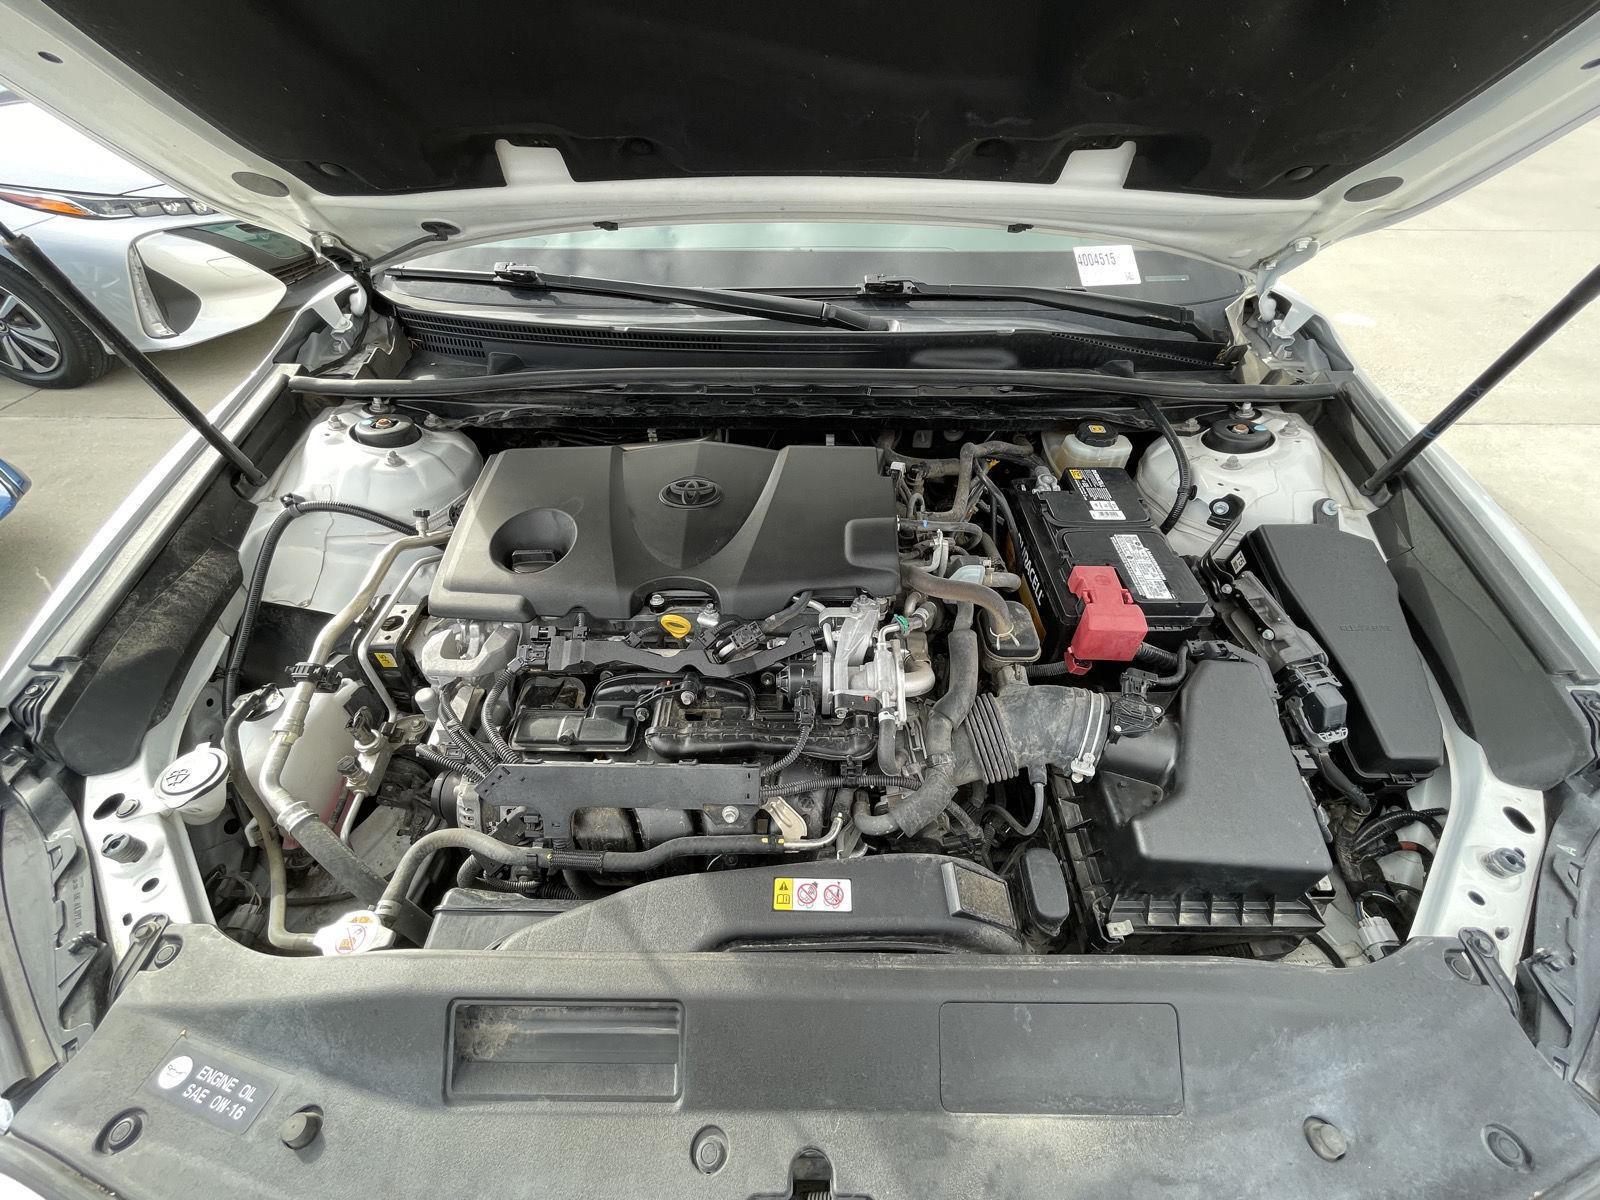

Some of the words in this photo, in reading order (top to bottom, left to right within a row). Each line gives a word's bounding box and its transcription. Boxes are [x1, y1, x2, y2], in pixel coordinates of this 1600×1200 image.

[1077, 252, 1117, 267] 4004515
[182, 1083, 210, 1104] SAE
[196, 1065, 240, 1093] ENGINE
[238, 1084, 257, 1103] OIL
